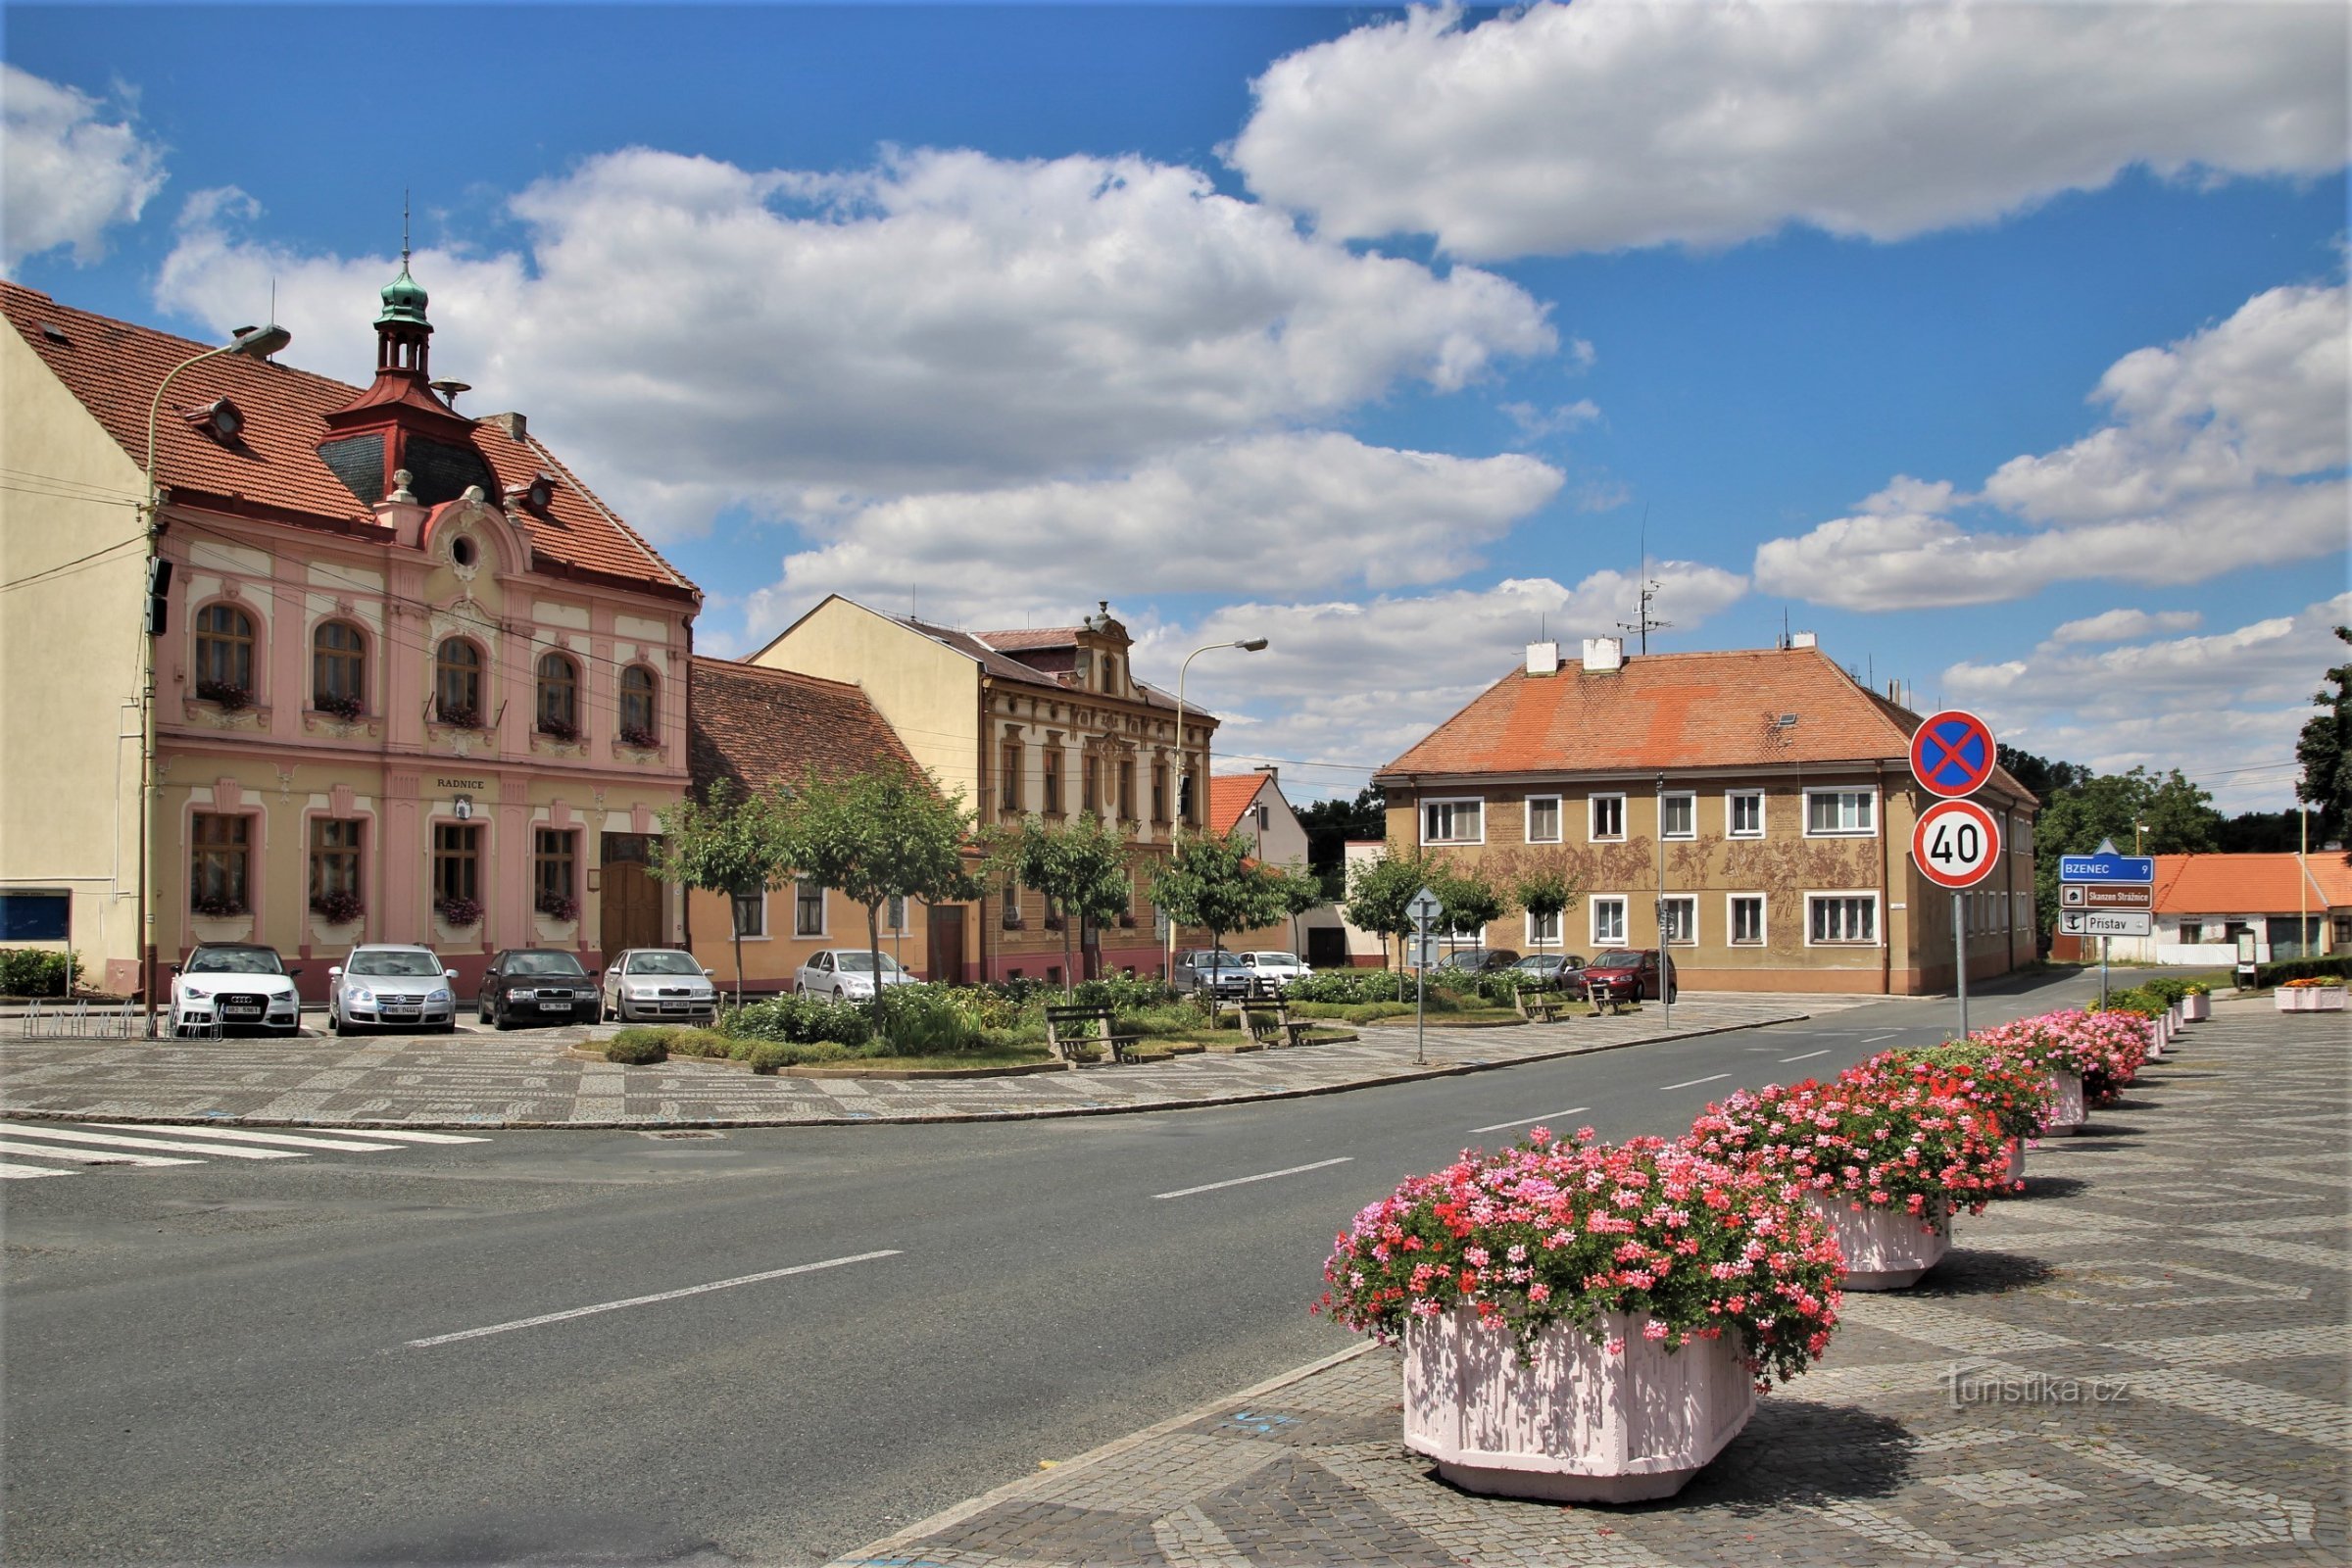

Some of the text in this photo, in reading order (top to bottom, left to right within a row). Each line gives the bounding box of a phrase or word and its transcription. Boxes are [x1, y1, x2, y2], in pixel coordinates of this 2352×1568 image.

[437, 778, 484, 790] RADNICE
[1930, 823, 1979, 864] 40
[2065, 863, 2148, 874] BZENEC 9
[2088, 891, 2149, 902] Skanzen Strážnice
[2089, 917, 2127, 930] Přístav
